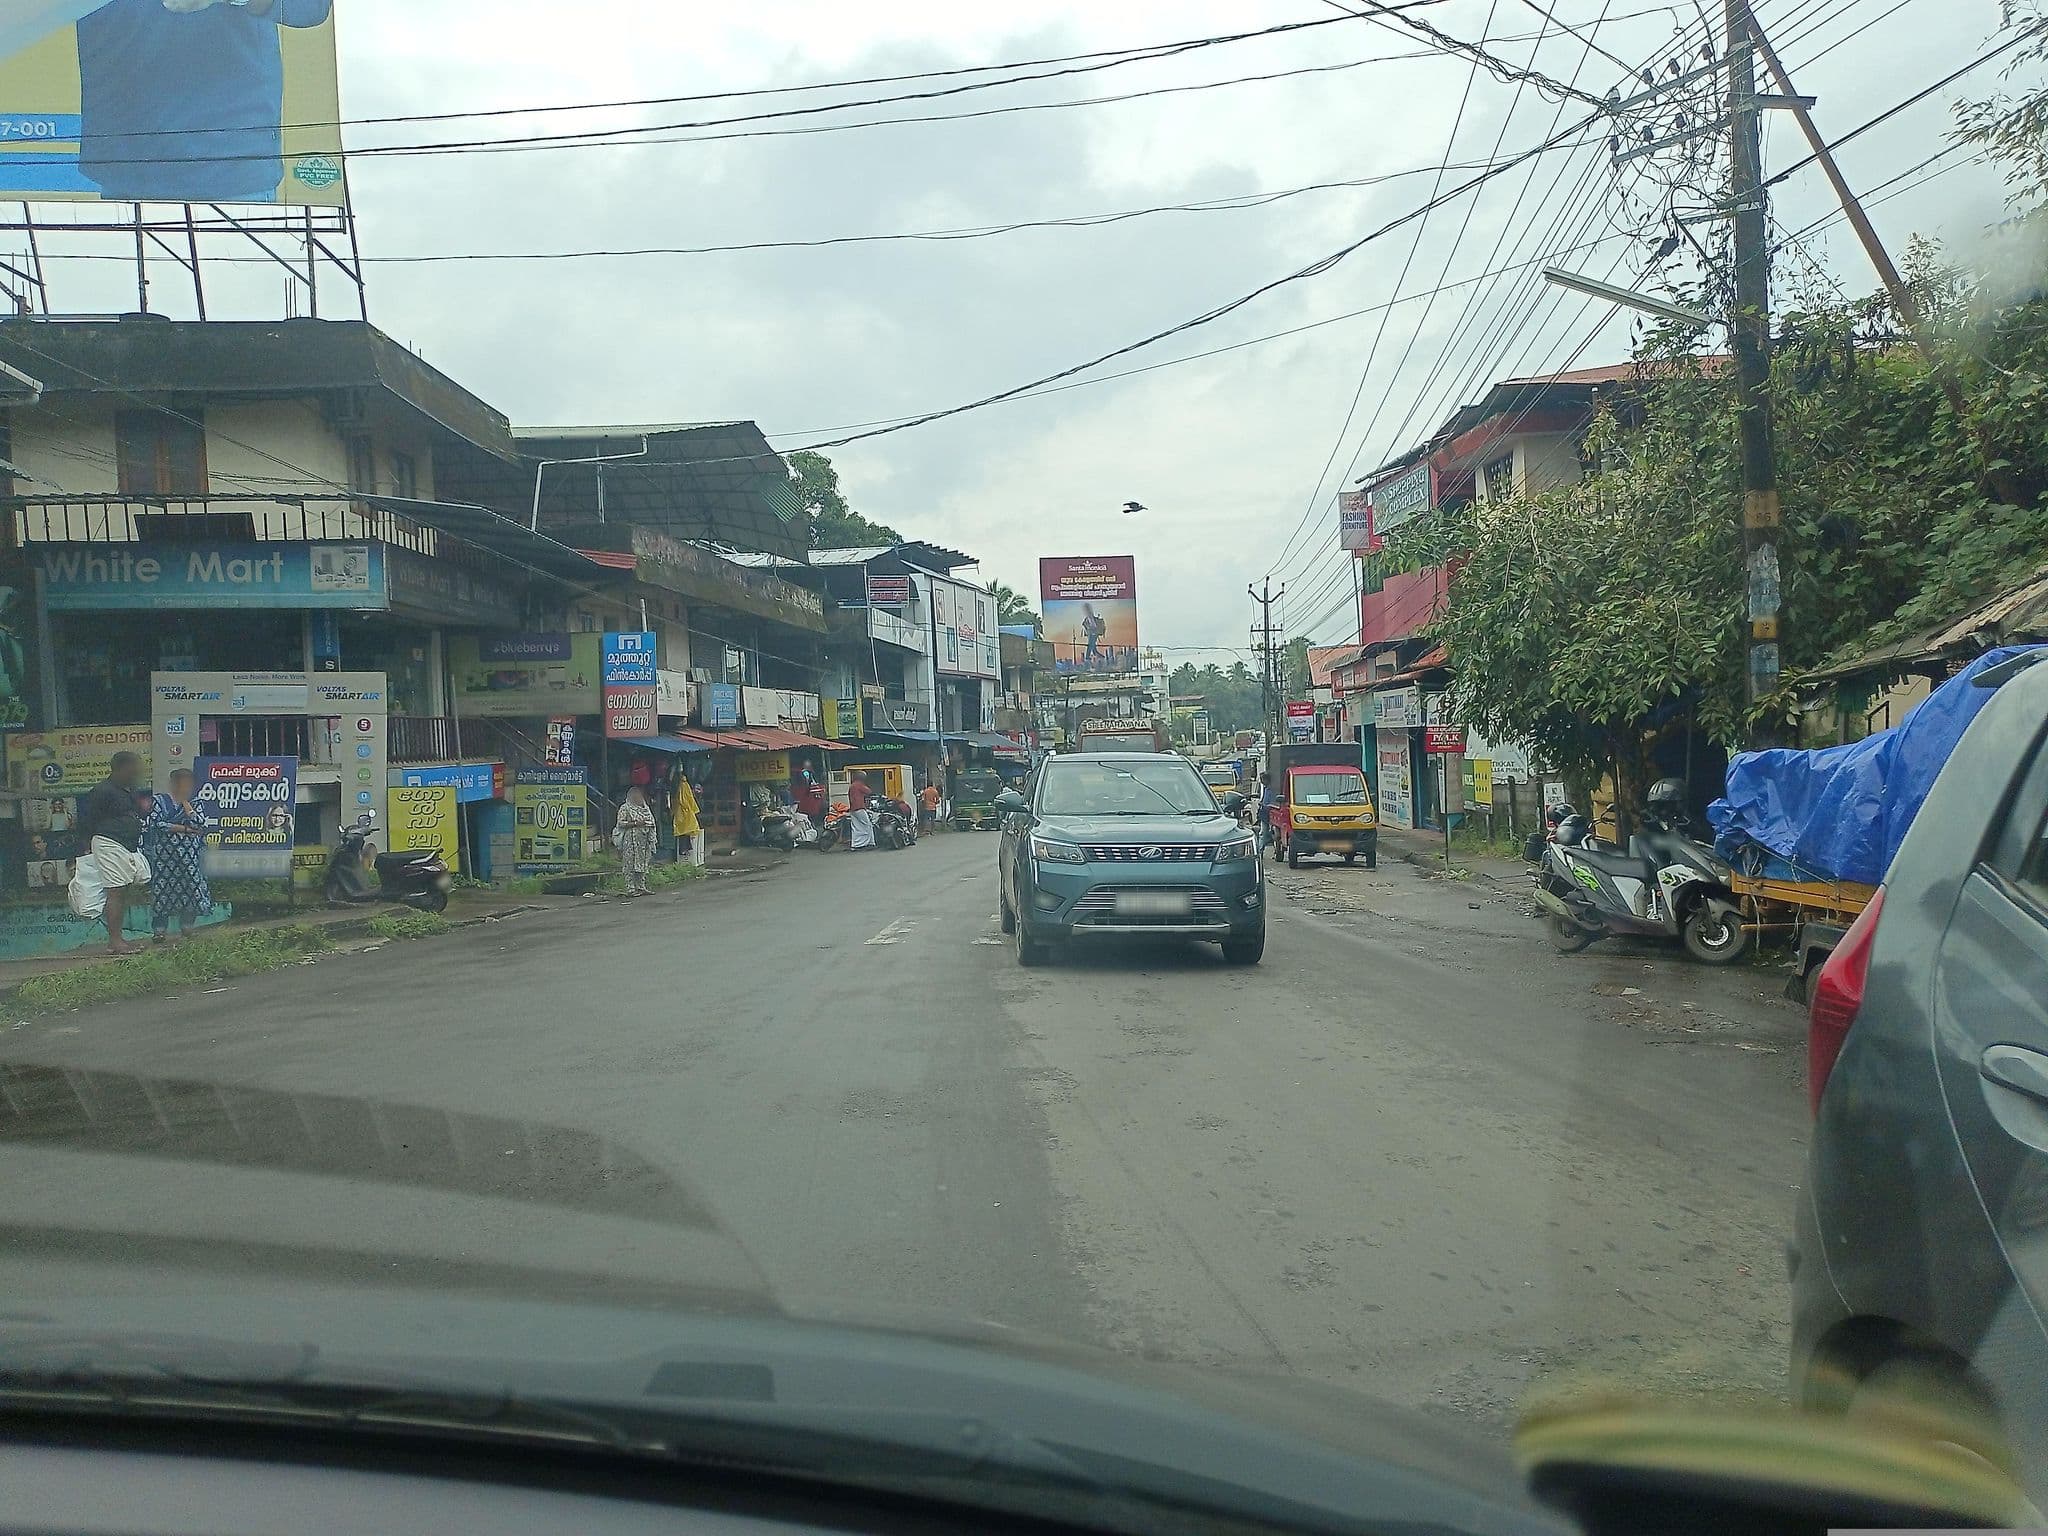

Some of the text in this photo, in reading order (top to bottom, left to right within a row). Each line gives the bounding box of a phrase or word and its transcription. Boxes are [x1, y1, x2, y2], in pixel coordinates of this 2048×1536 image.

[1388, 470, 1425, 499] SHOPPING
[1388, 488, 1426, 513] COMPLEX
[1342, 511, 1367, 522] FASHION
[1342, 522, 1368, 530] FURNITURE
[46, 551, 161, 584] White
[187, 551, 284, 584] Mart
[164, 692, 222, 700] SMARTAIR
[325, 692, 380, 700] SMARTAIR
[739, 760, 785, 772] HOTEL
[198, 777, 290, 809] കണ്ണടകൾ
[536, 801, 566, 831] 0%
